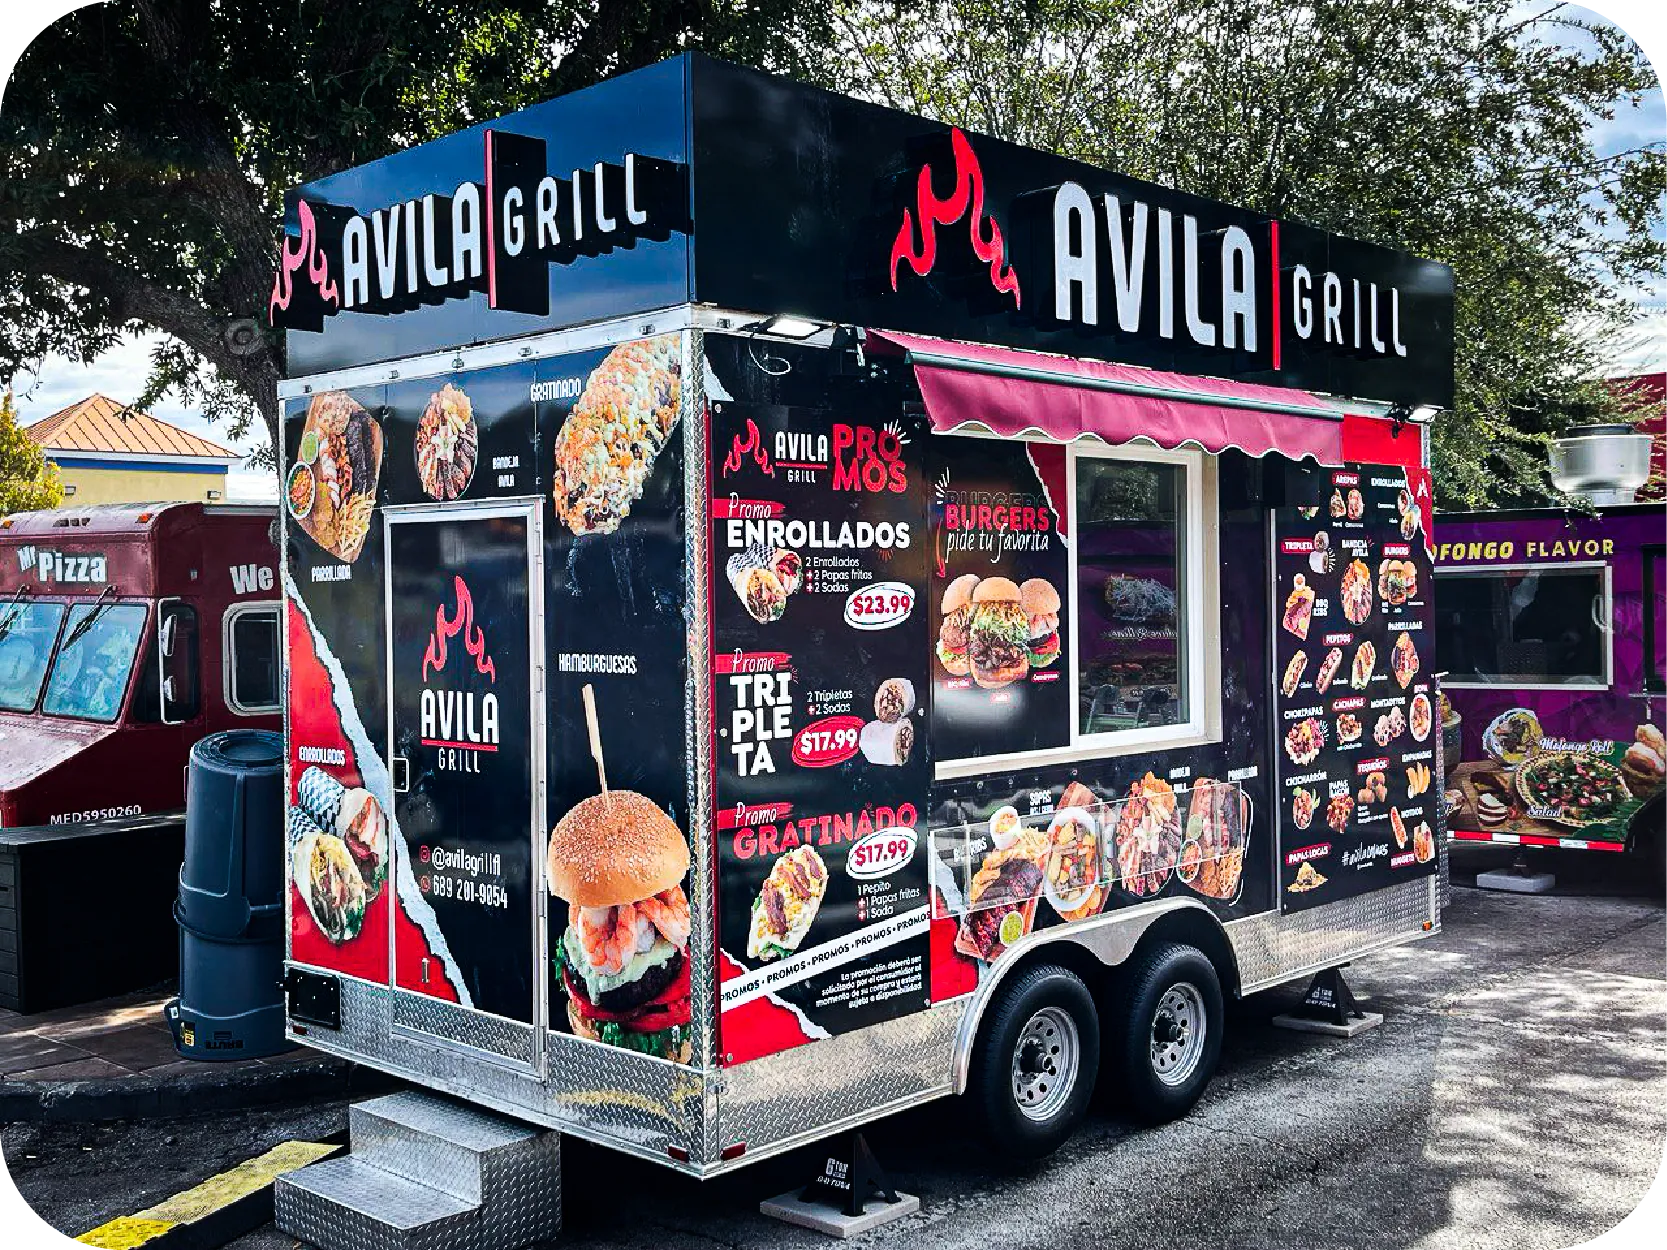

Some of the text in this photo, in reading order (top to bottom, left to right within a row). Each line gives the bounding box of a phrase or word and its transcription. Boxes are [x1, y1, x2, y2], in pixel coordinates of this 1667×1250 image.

[343, 153, 648, 309] AVILA GRILL
[1053, 181, 1408, 358] AVILA GRILL
[530, 378, 582, 402] GRATINADO
[775, 431, 828, 462] AVILA
[832, 423, 902, 461] PRO
[787, 469, 816, 483] GRILL
[832, 457, 908, 493] MOS
[729, 492, 772, 519] Promo
[945, 504, 1050, 531] BURGERS
[727, 520, 910, 549] ENROLLADOS
[945, 520, 1049, 563] pide tu favorita
[805, 556, 860, 567] 2 Enrollados
[1432, 538, 1614, 561] FONGO FLAVOR
[38, 552, 107, 583] Pizza
[229, 563, 274, 595] We
[814, 570, 820, 580] 2
[822, 570, 850, 582] Papas
[814, 583, 820, 592] 2
[822, 582, 849, 593] Sodas
[853, 594, 910, 616] $23.99
[558, 653, 638, 674] HAMBURGUESAS
[732, 647, 776, 674] Promo
[729, 672, 793, 708] TRI
[806, 692, 813, 702] 2
[420, 689, 500, 744] AVILA
[815, 705, 821, 715] 2
[822, 702, 851, 715] Sodas
[732, 706, 793, 743] PLE
[800, 728, 858, 755] $17.99
[438, 747, 481, 773] GRILL
[731, 741, 776, 777] TA
[735, 802, 777, 827] Promo
[733, 802, 918, 859] GRATINADO
[853, 840, 909, 867] $17.99
[433, 874, 508, 909] 689 201-9054
[863, 882, 892, 898] Pepito
[870, 895, 898, 908] Papas
[870, 906, 894, 920] Soda
[767, 961, 806, 984] PROMOS
[811, 943, 850, 966] PROMOS
[855, 926, 892, 949] PROMOS
